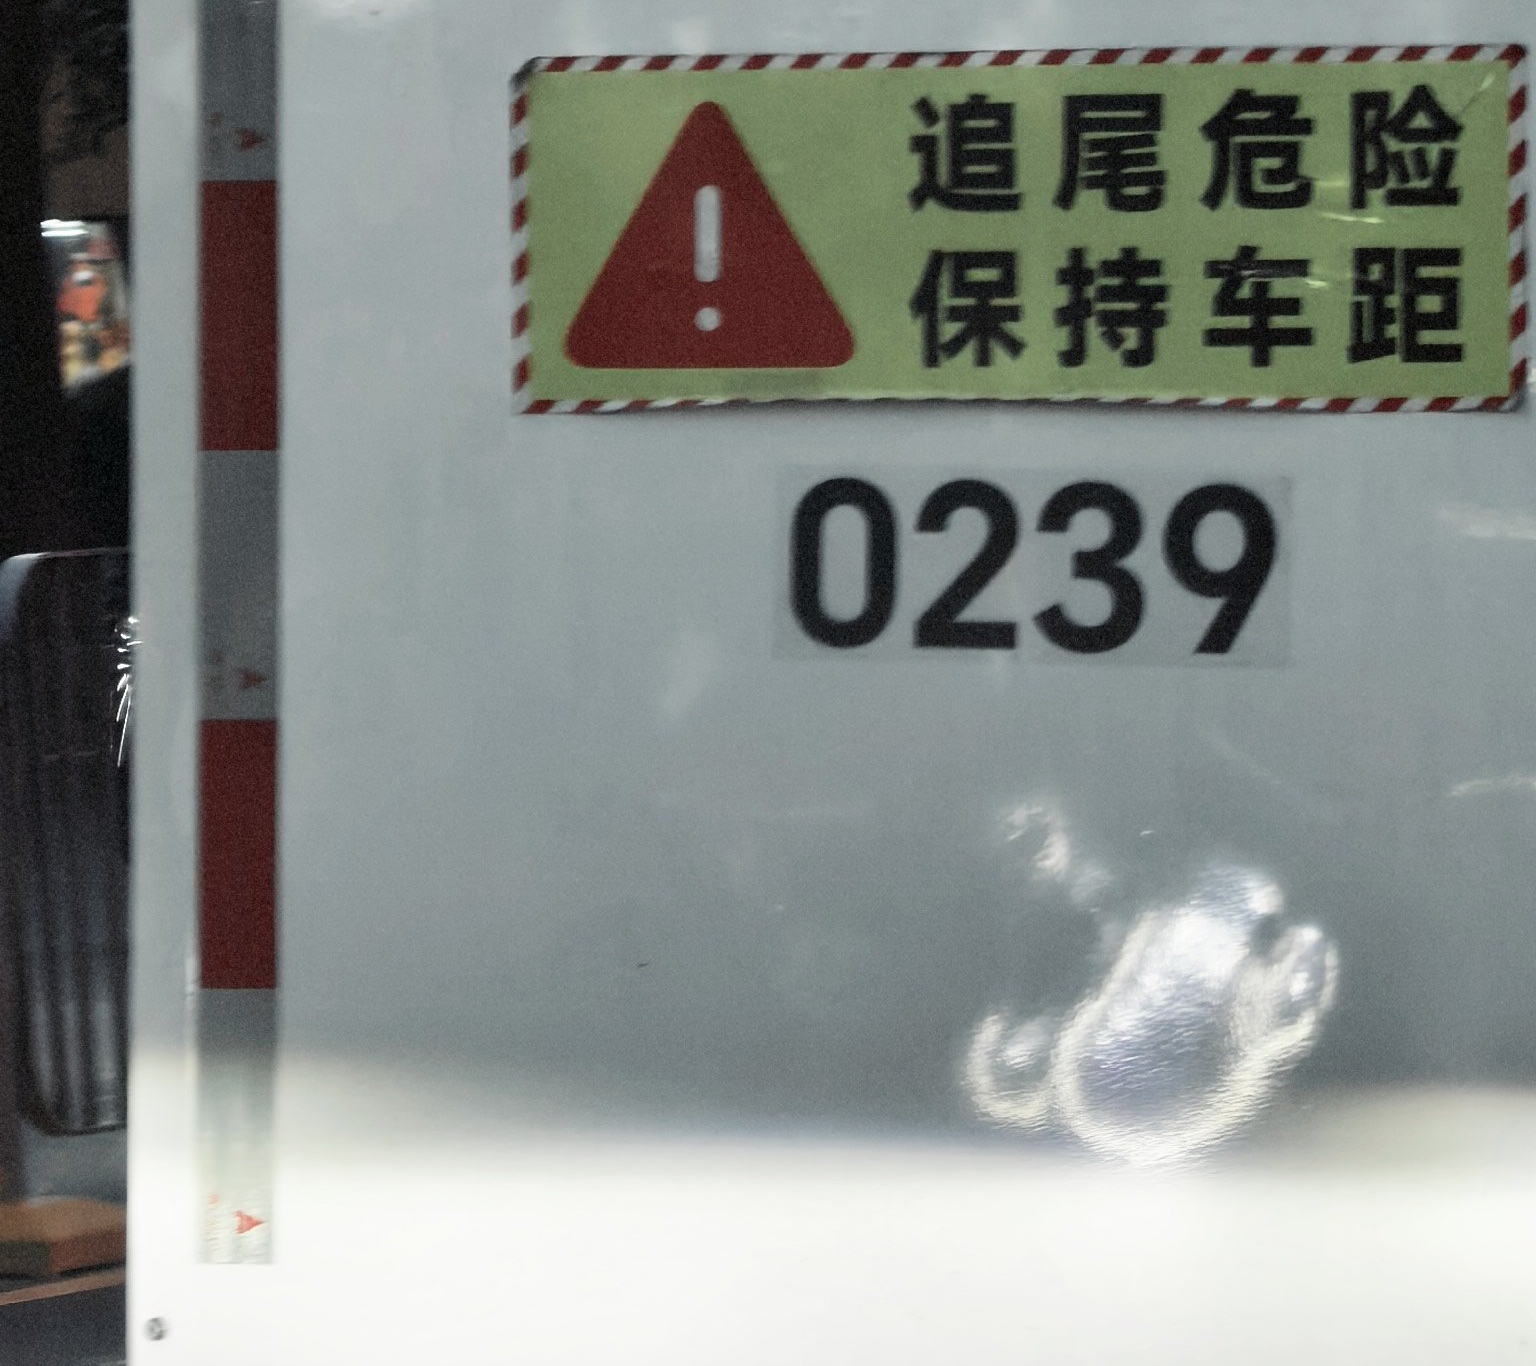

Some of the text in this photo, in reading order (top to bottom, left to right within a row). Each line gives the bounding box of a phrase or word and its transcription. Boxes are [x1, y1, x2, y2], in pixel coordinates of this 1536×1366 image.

[908, 85, 1464, 213] 追尾危险
[908, 245, 1466, 369] 保持车距
[788, 476, 1278, 656] 0239
